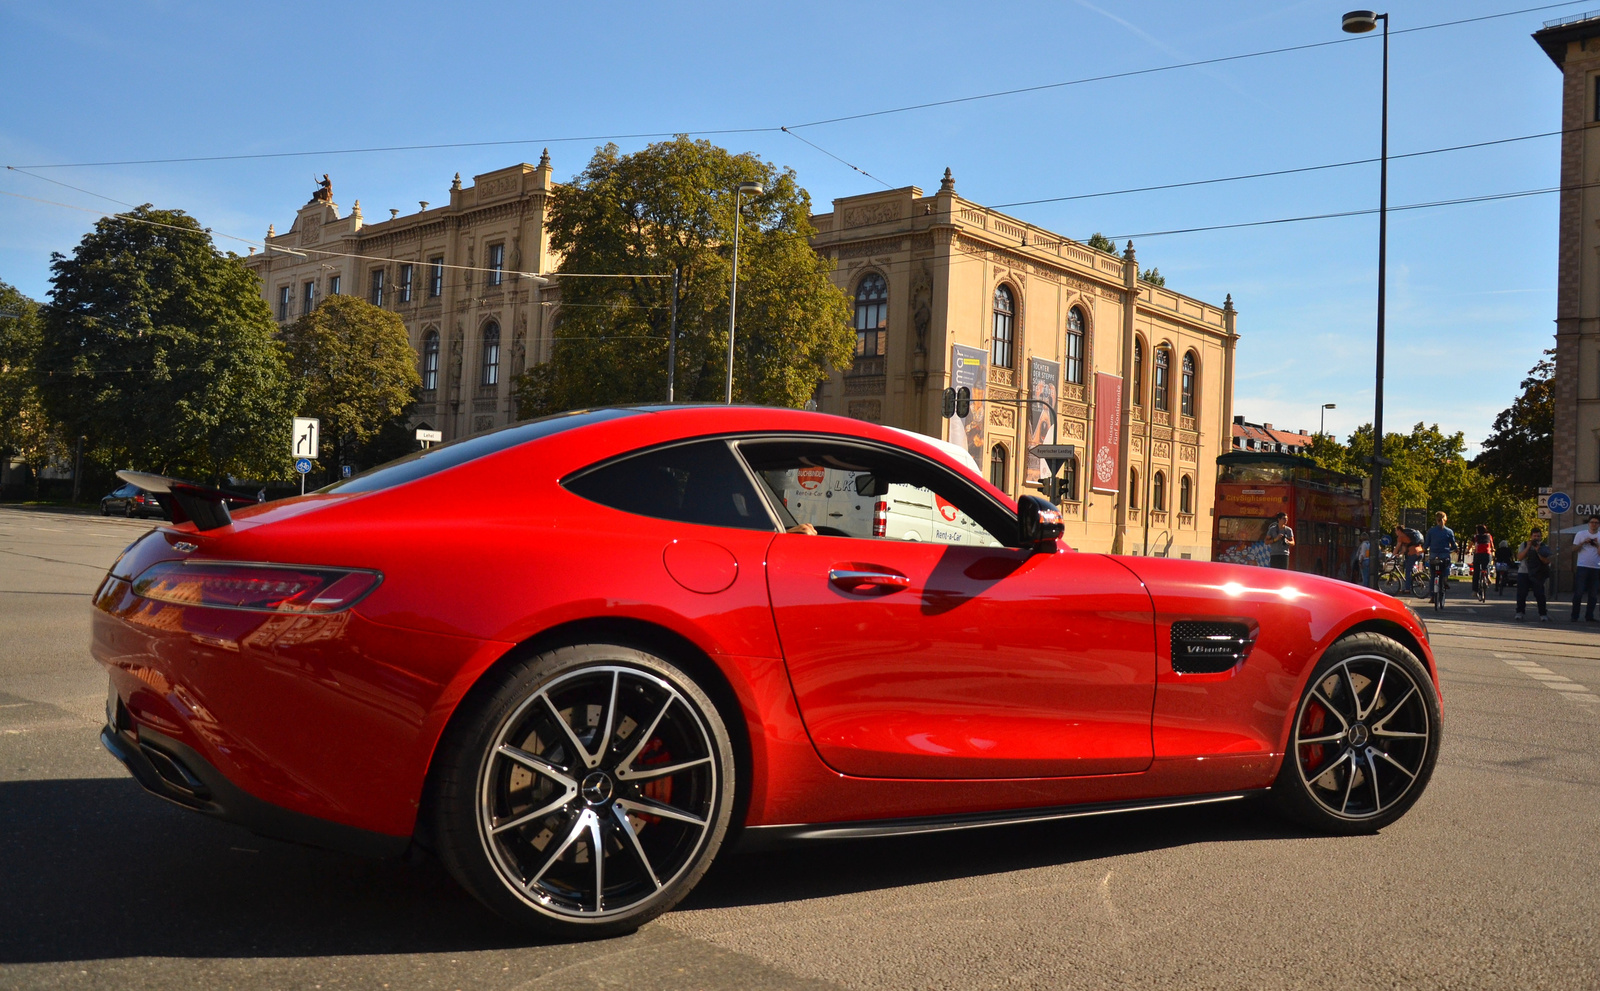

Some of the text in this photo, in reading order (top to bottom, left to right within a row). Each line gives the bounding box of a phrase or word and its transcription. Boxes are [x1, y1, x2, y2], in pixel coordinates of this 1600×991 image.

[1033, 362, 1050, 372] TÖCHTER
[1033, 370, 1055, 381] DER STEPPE
[834, 480, 856, 491] LK
[1226, 494, 1283, 504] CitySightseeing
[935, 529, 962, 541] Rent-a-Car
